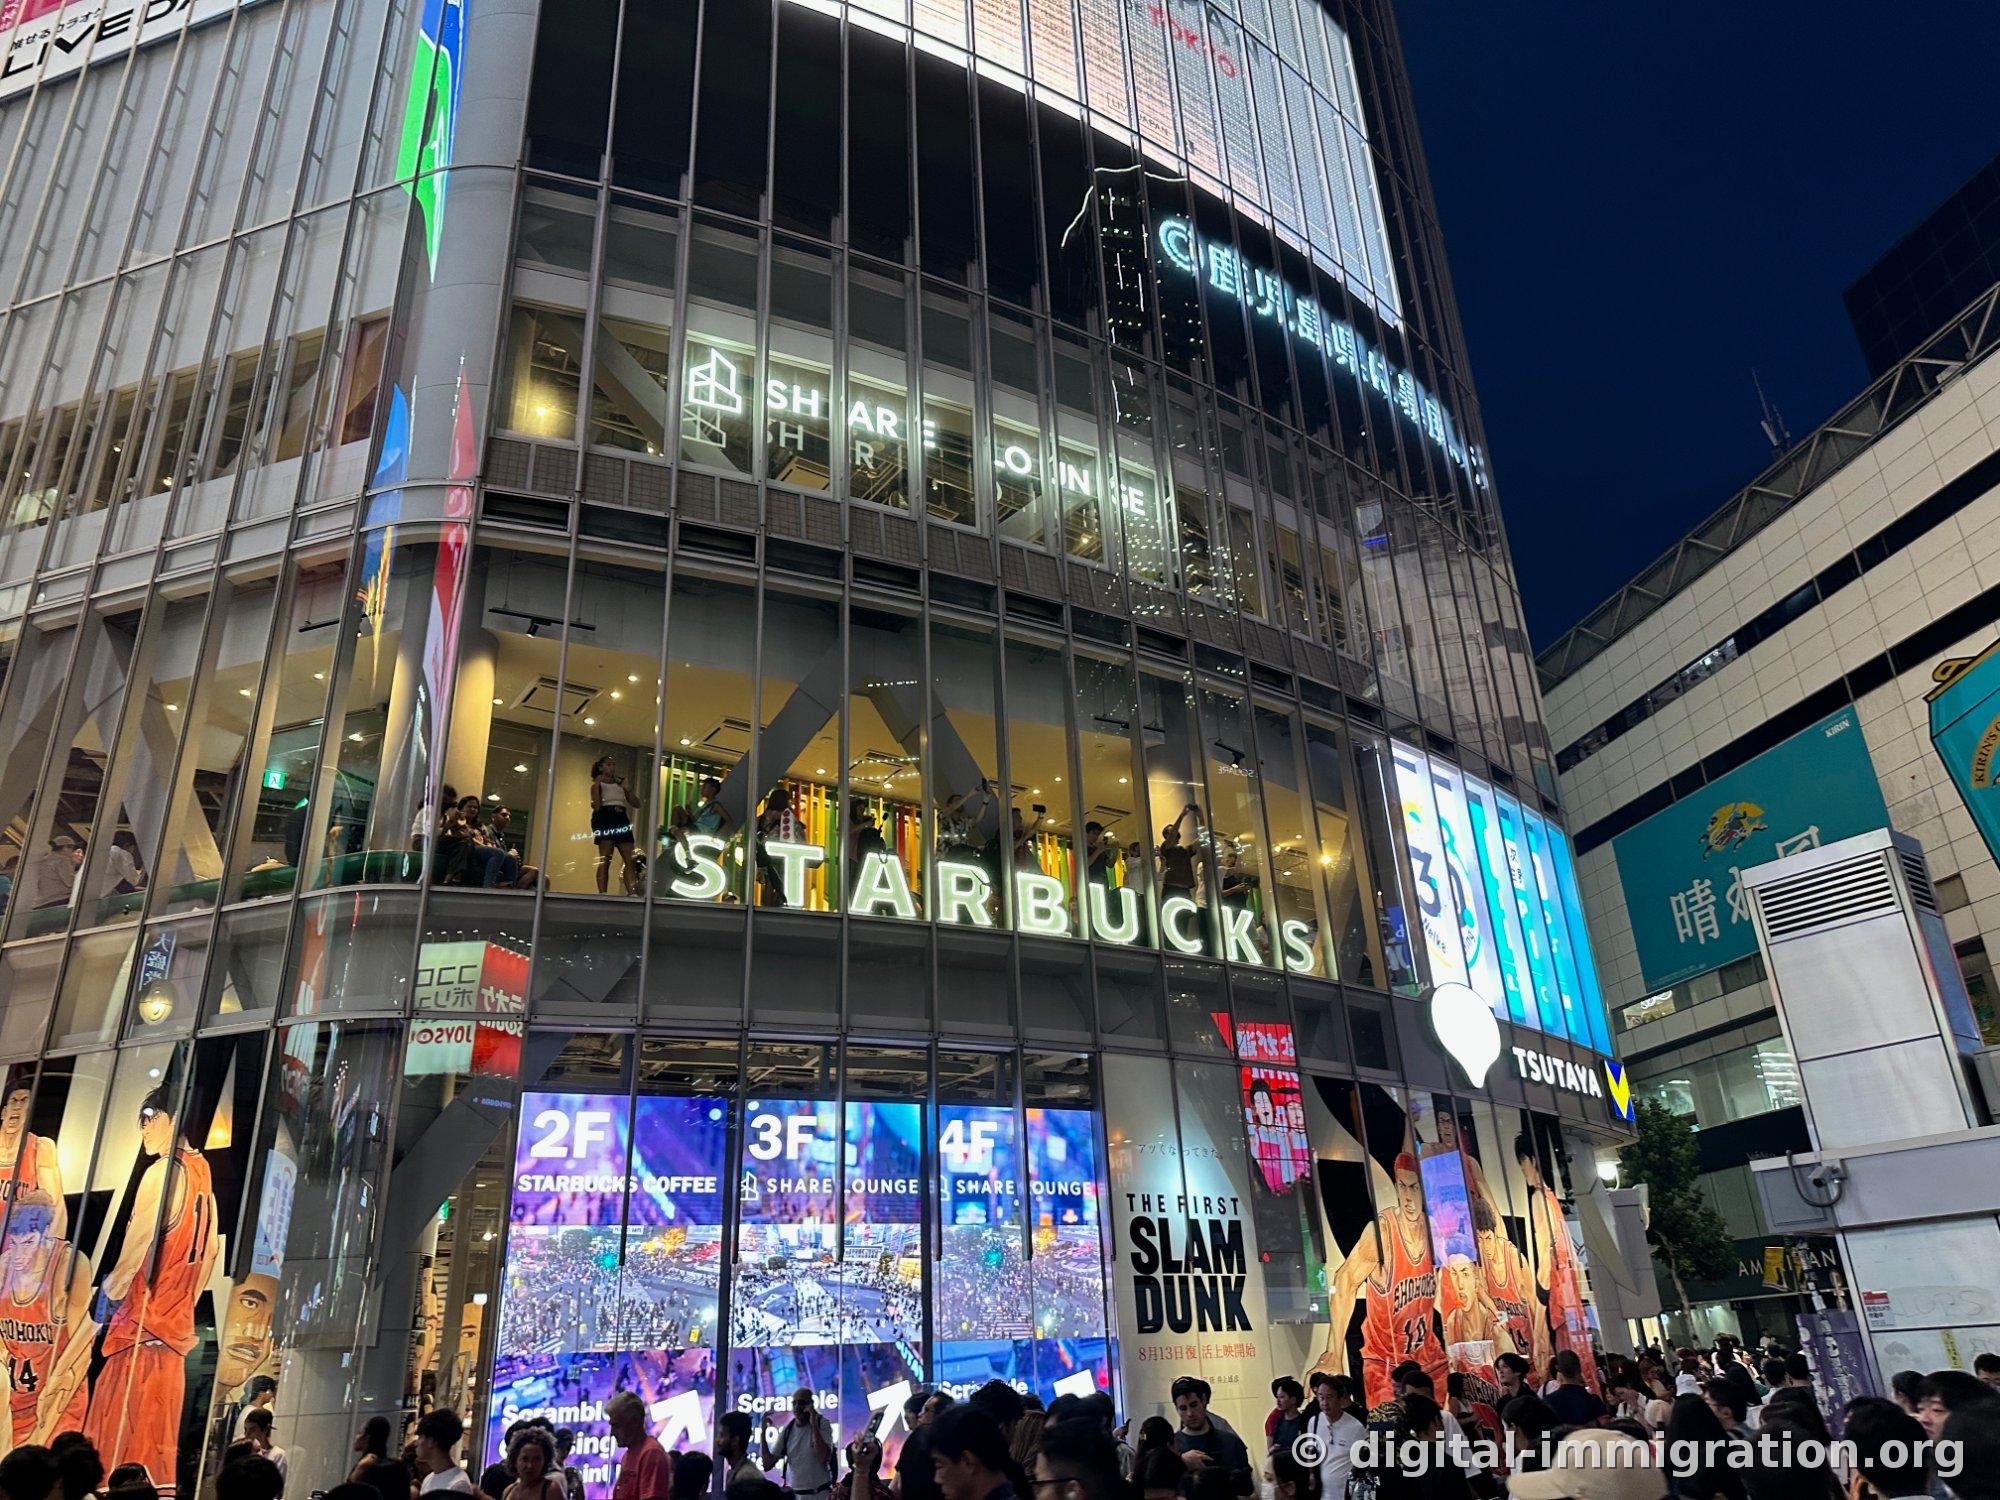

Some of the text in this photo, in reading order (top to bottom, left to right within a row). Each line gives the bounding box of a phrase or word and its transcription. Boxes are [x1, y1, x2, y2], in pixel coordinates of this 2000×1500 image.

[1824, 719, 1849, 738] KIRIN
[670, 836, 1315, 975] STARBUCKS
[1512, 1046, 1603, 1098] TSUTAYA
[530, 1110, 611, 1159] 2F
[748, 1114, 818, 1160] 3F
[939, 1119, 998, 1164] 4F
[517, 1174, 717, 1194] STARBUCKS COFFEE
[766, 1178, 833, 1194] SHARE
[956, 1180, 1092, 1196] SHARE OUNGE
[1126, 1193, 1239, 1216] THE FIRST
[1129, 1215, 1247, 1275] SLAM
[1133, 1275, 1253, 1335] DUNK
